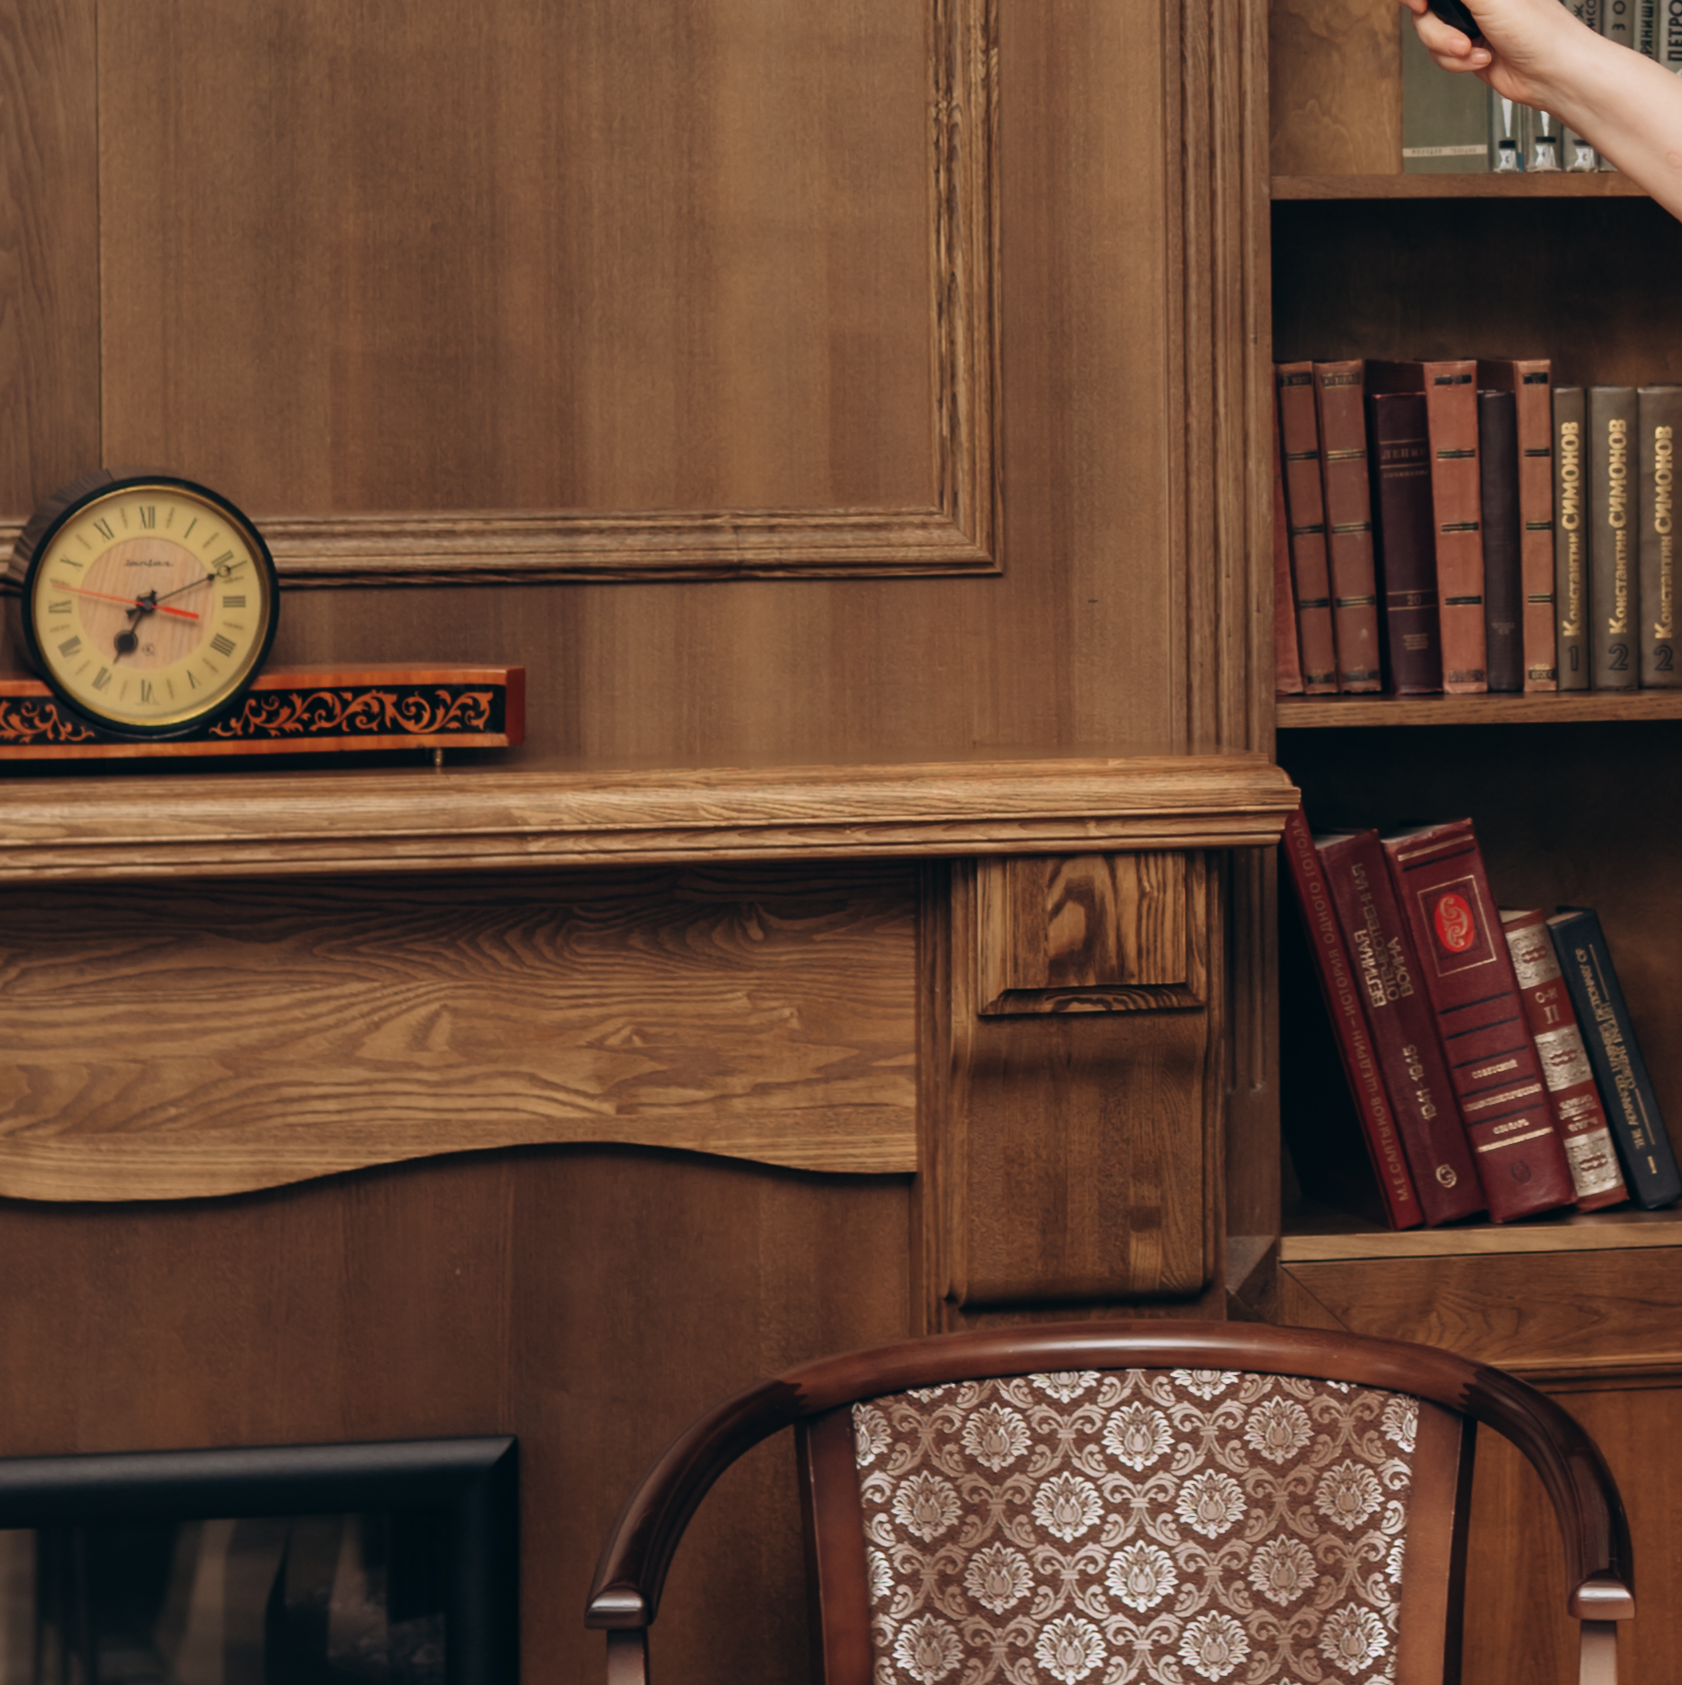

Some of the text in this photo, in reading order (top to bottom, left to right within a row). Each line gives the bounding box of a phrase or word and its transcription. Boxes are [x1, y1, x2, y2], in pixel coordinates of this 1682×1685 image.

[1561, 421, 1580, 530] СИМОНОВ
[1608, 418, 1627, 528] СИМОНОВ
[1653, 425, 1673, 535] СИМОНОВ
[1568, 646, 1579, 672] 1
[1608, 643, 1630, 672] 2
[1654, 644, 1674, 672] 2
[1290, 817, 1316, 880] ГОРОДА
[1308, 883, 1335, 945] ОДНОГО
[1326, 947, 1355, 1017] ИСТОРИЯ
[1351, 928, 1388, 1009] ВЕЛИКАЯ
[1385, 936, 1415, 998] ВОЙНА
